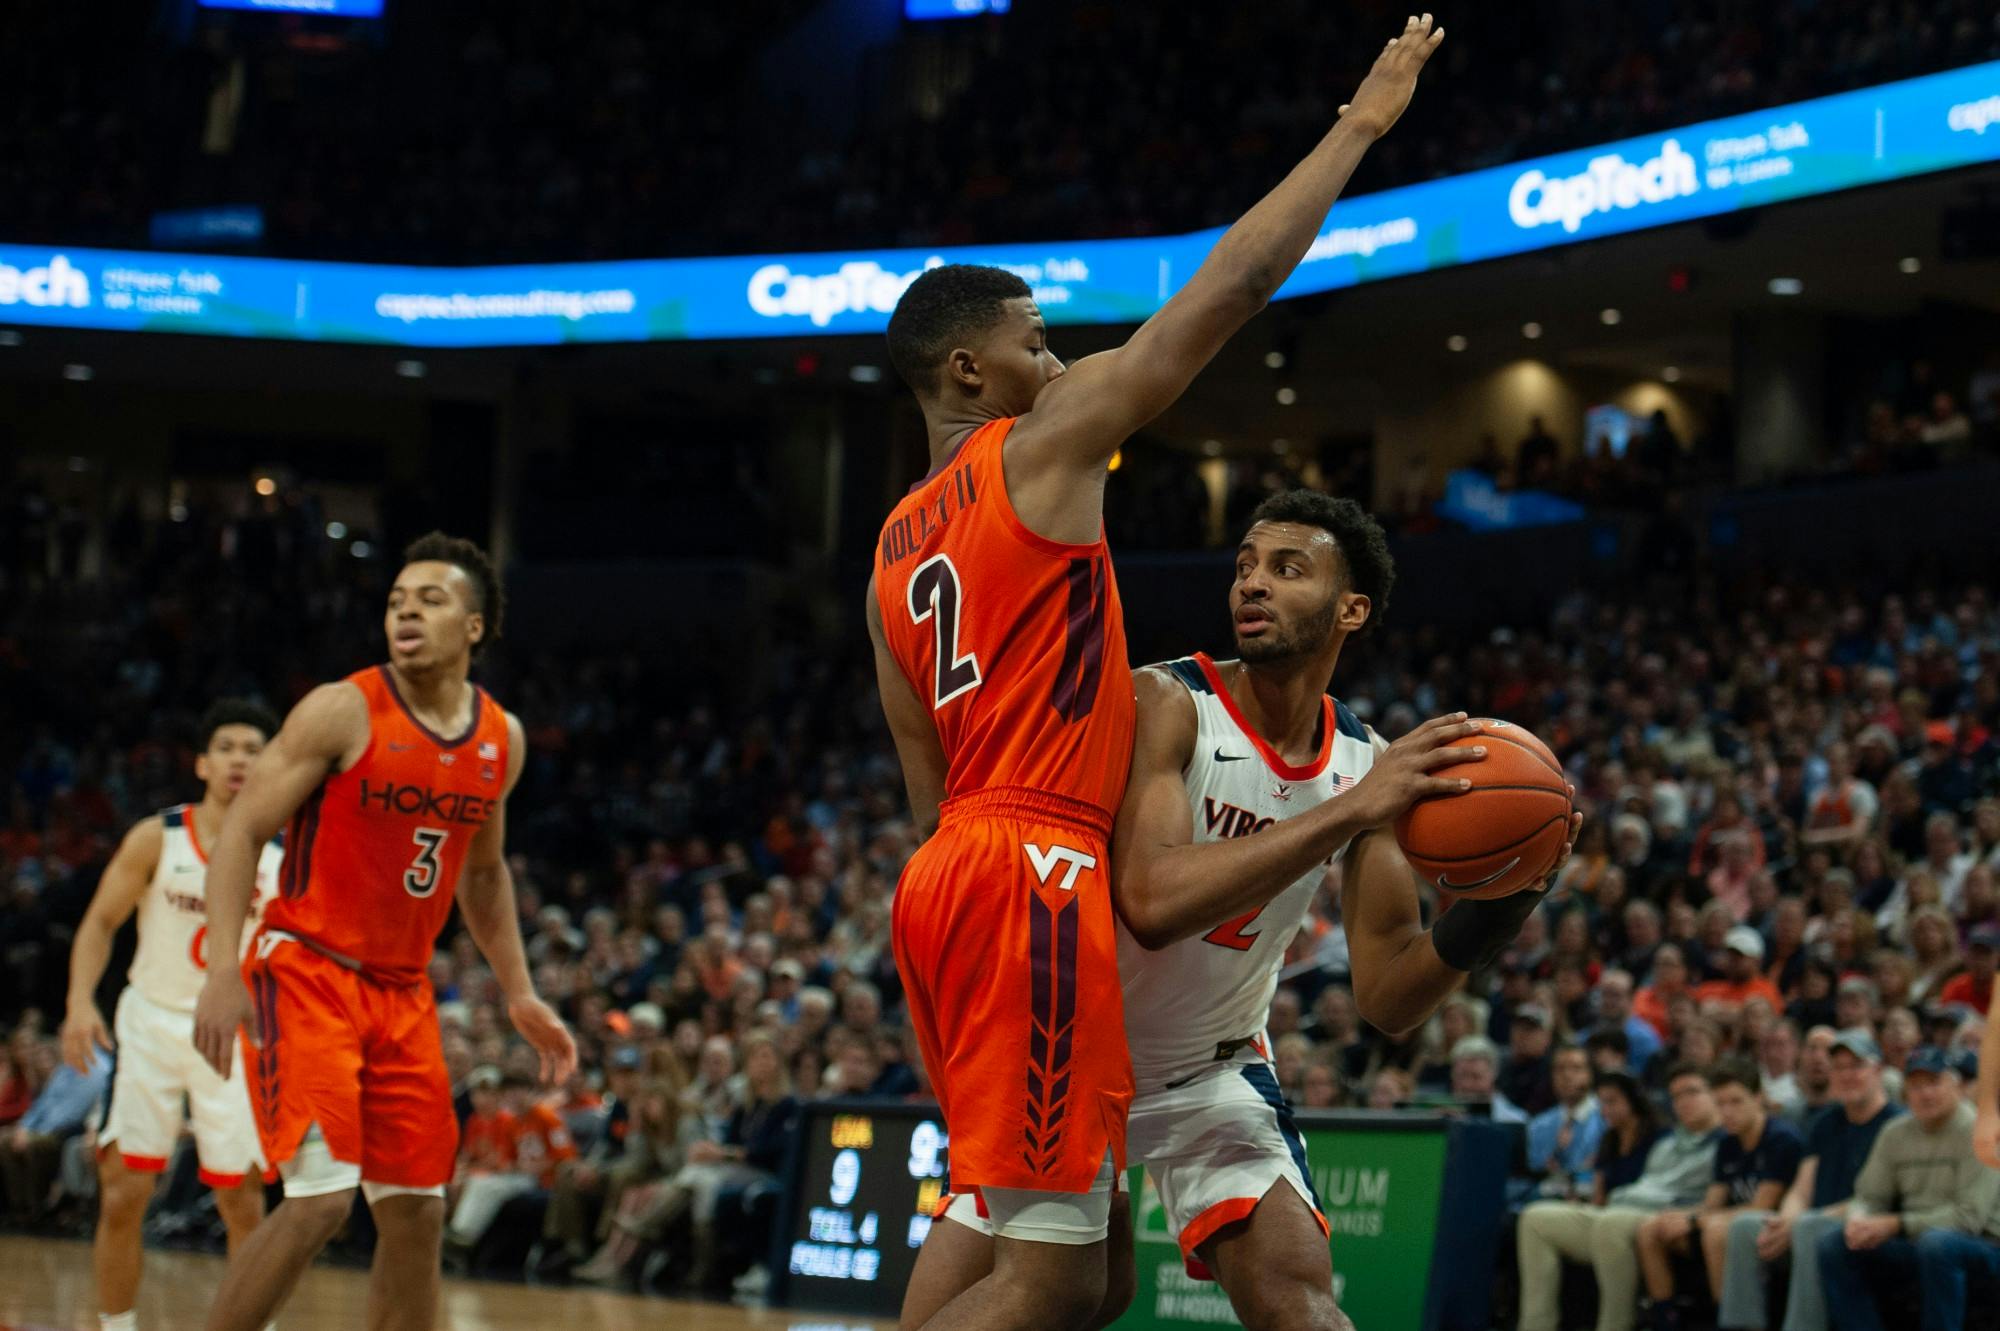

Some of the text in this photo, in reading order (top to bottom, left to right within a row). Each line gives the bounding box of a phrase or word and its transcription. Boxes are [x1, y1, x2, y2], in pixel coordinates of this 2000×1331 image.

[1508, 138, 1698, 233] CapTech
[747, 255, 944, 327] CapTe
[906, 553, 982, 711] 2
[403, 827, 449, 898] 3
[1023, 842, 1097, 892] VT
[830, 1149, 861, 1206] 9
[1311, 1167, 1390, 1207] IUM
